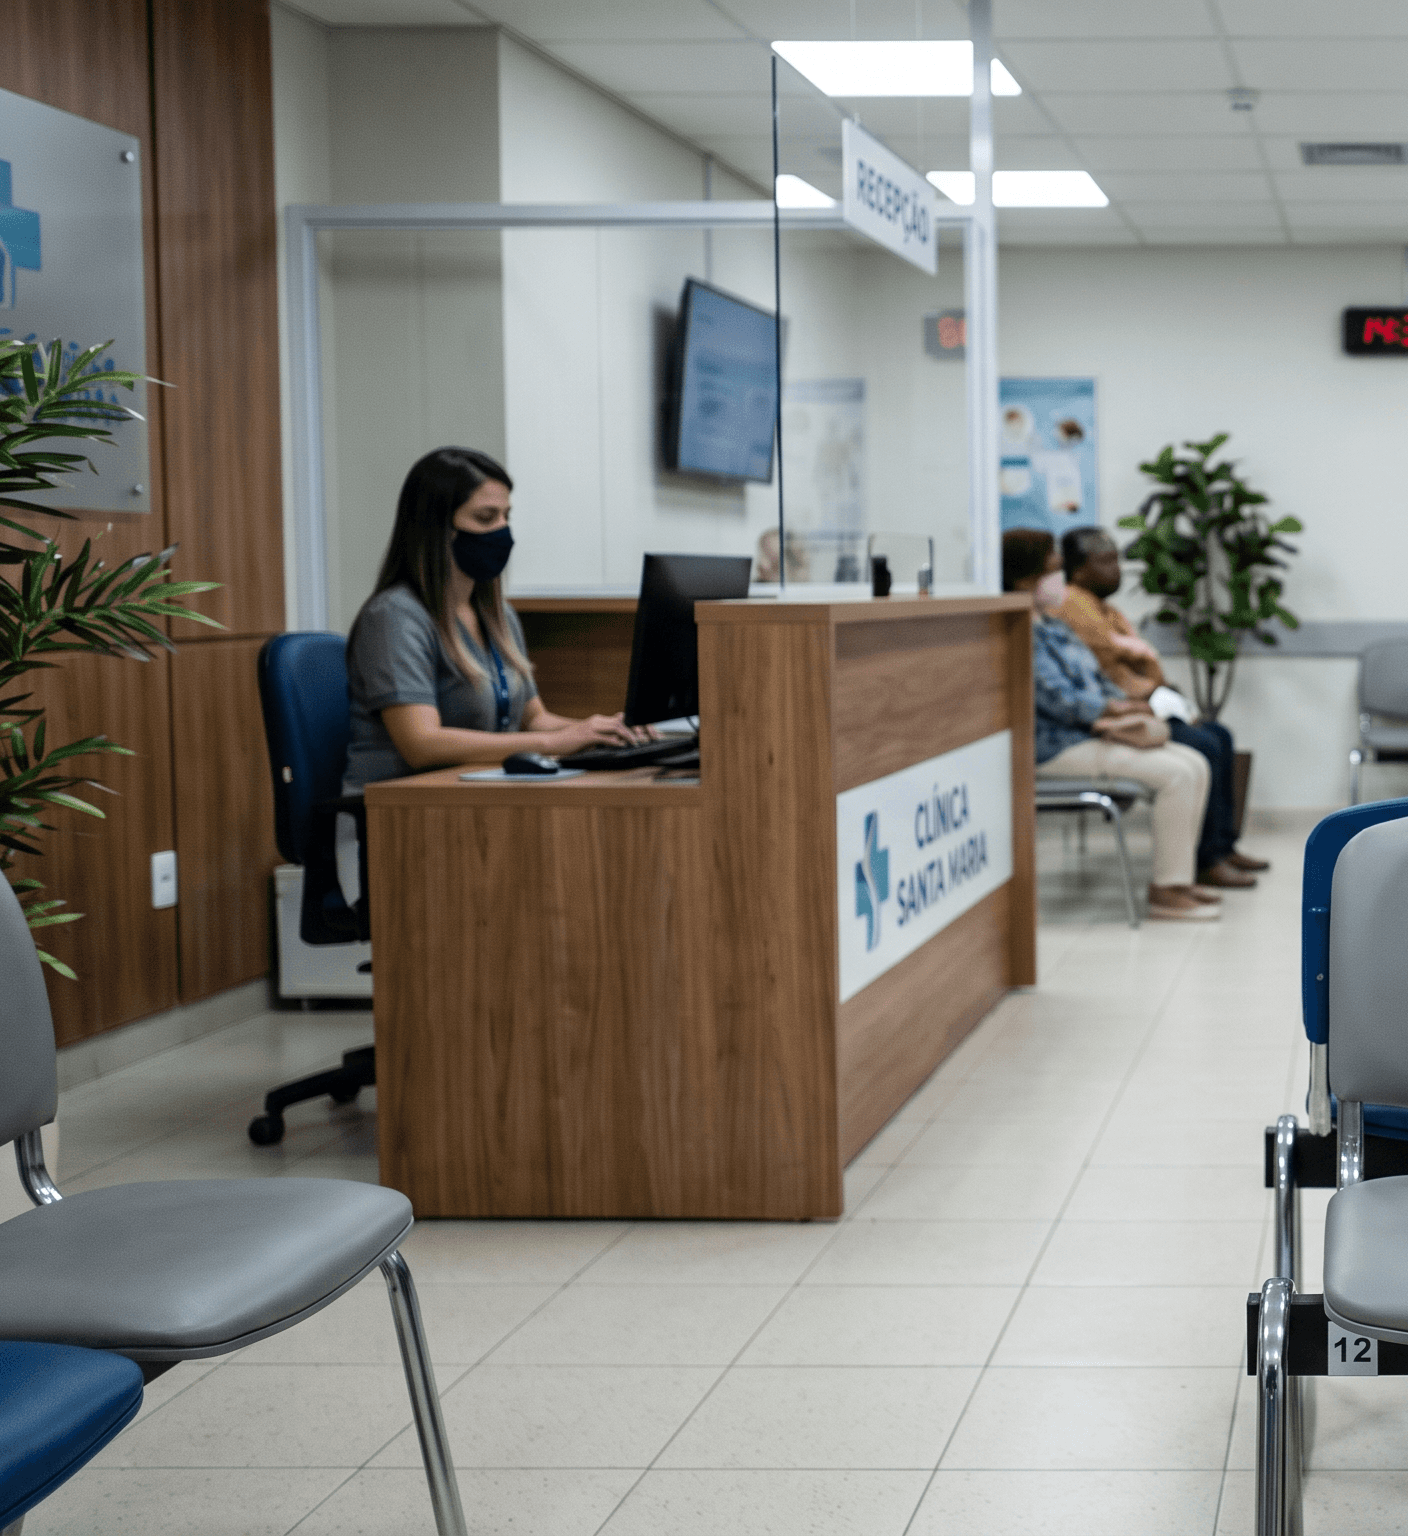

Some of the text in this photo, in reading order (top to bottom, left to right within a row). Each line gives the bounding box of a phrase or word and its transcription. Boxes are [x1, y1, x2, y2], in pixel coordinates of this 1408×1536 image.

[857, 158, 930, 245] RECEPÇÃO
[914, 783, 970, 850] CLÍNICA
[896, 831, 988, 928] SANTA MARIA
[1334, 1336, 1372, 1363] 12
